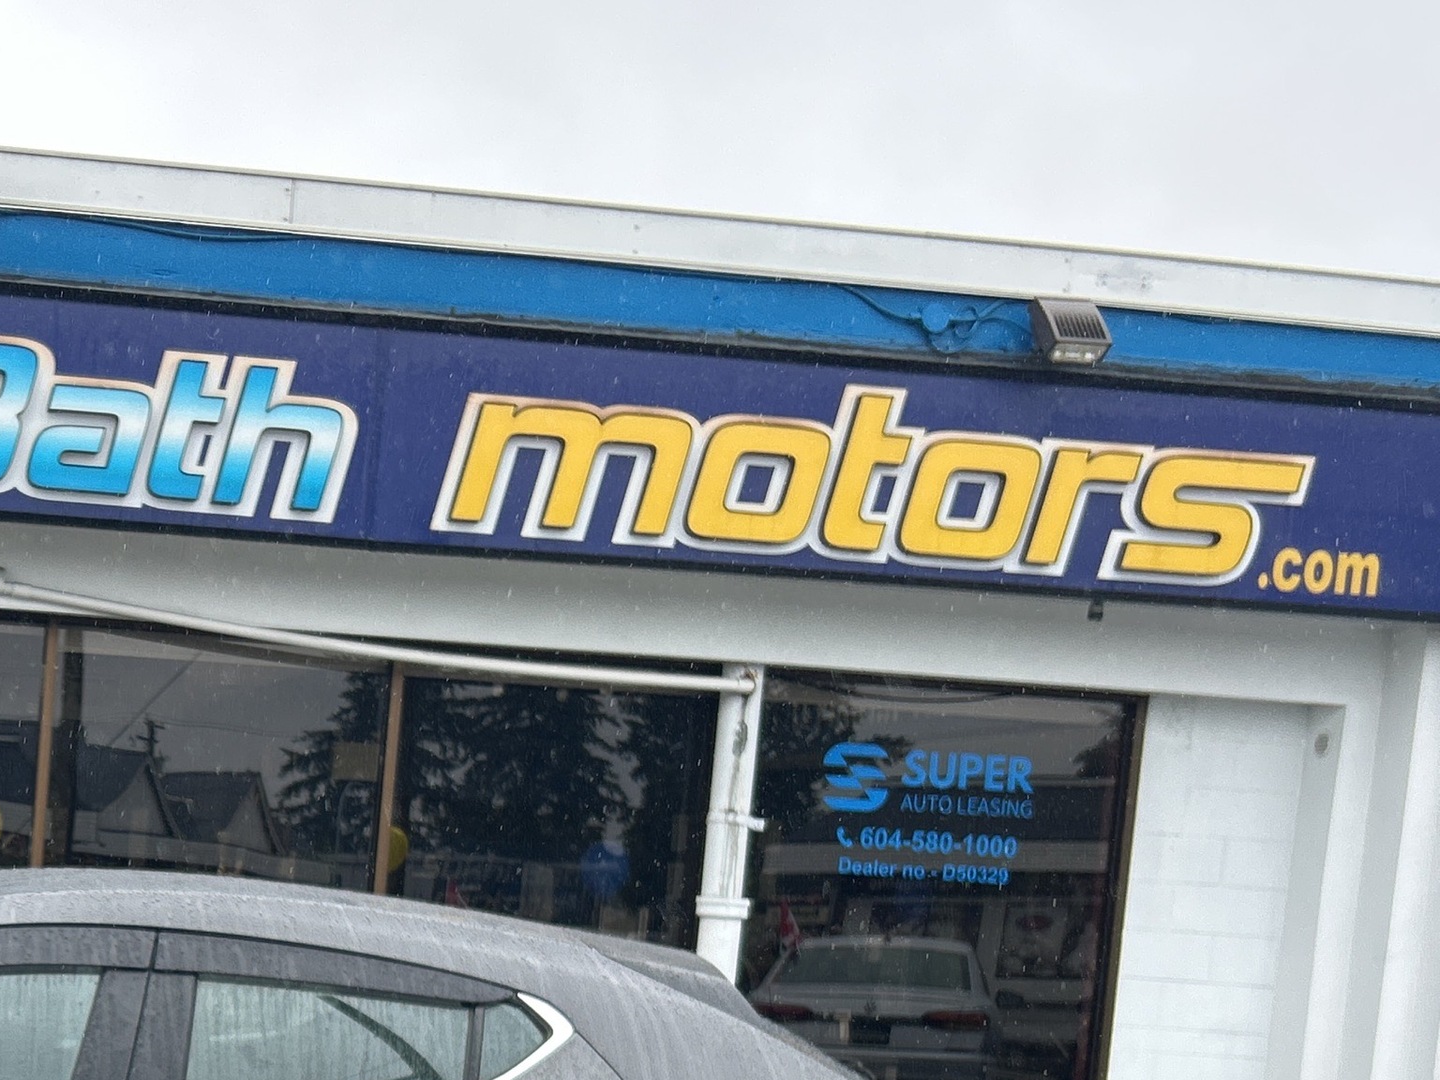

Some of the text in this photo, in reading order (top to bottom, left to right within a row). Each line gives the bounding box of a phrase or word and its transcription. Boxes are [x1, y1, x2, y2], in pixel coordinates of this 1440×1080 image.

[431, 384, 1315, 585] motors
[901, 749, 1035, 795] SUPER
[900, 793, 1035, 820] AUTO LEASING
[860, 827, 1017, 857] 604-580-1000
[838, 856, 897, 878] Dealer
